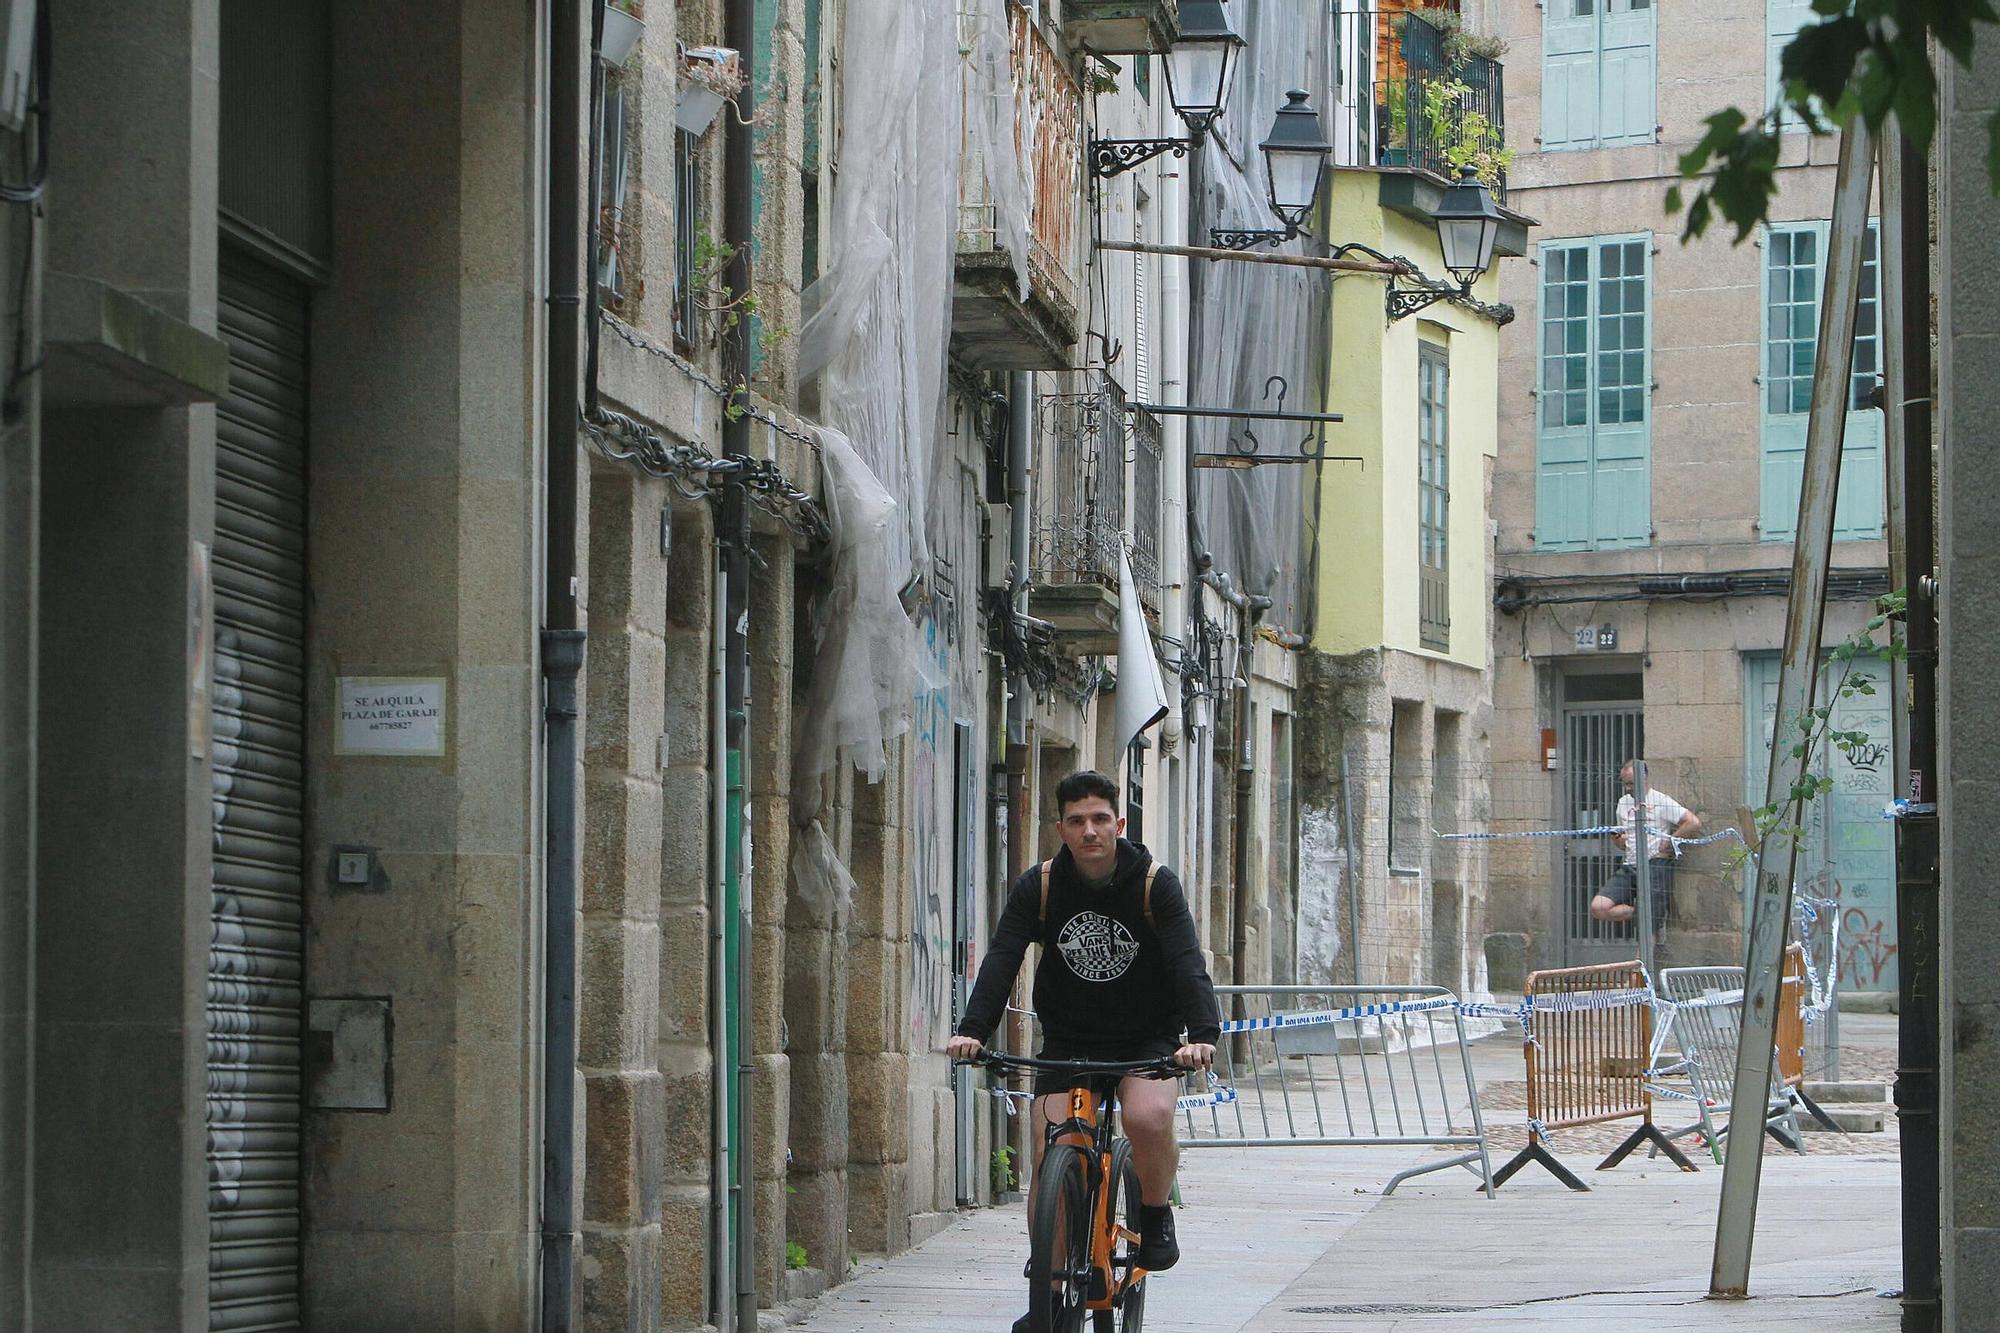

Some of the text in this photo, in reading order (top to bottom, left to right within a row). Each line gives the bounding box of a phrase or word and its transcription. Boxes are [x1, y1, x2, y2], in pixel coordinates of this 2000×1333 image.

[1577, 629, 1593, 645] 22
[1600, 633, 1613, 645] 22
[354, 695, 425, 708] SE ALQUILA
[341, 708, 440, 720] PLAZA DE GARAJE
[1063, 920, 1080, 936] THE
[1079, 934, 1110, 948] VANS
[1065, 948, 1084, 957] OFF
[1084, 946, 1107, 957] THE
[1073, 963, 1101, 979] SINCE
